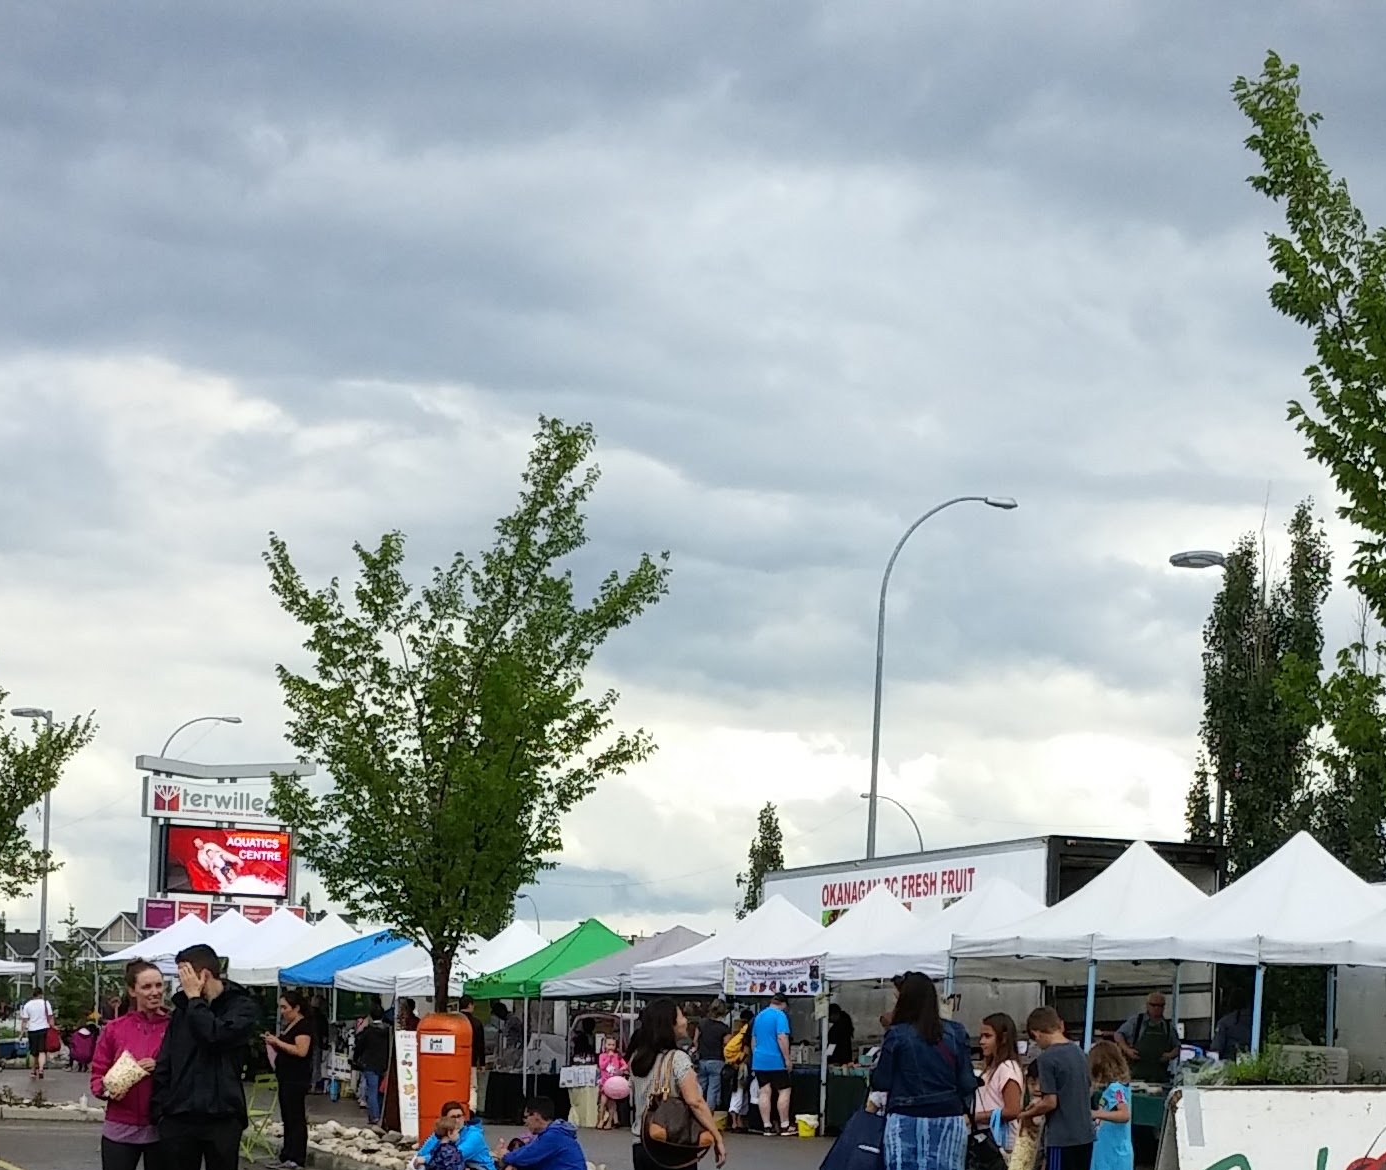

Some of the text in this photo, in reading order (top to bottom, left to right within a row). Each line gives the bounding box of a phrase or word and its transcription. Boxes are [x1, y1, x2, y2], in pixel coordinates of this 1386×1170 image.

[226, 837, 279, 849] AQUATICS
[239, 850, 282, 861] CENTRE
[901, 872, 937, 900] FRESH
[941, 867, 976, 895] FRUIT
